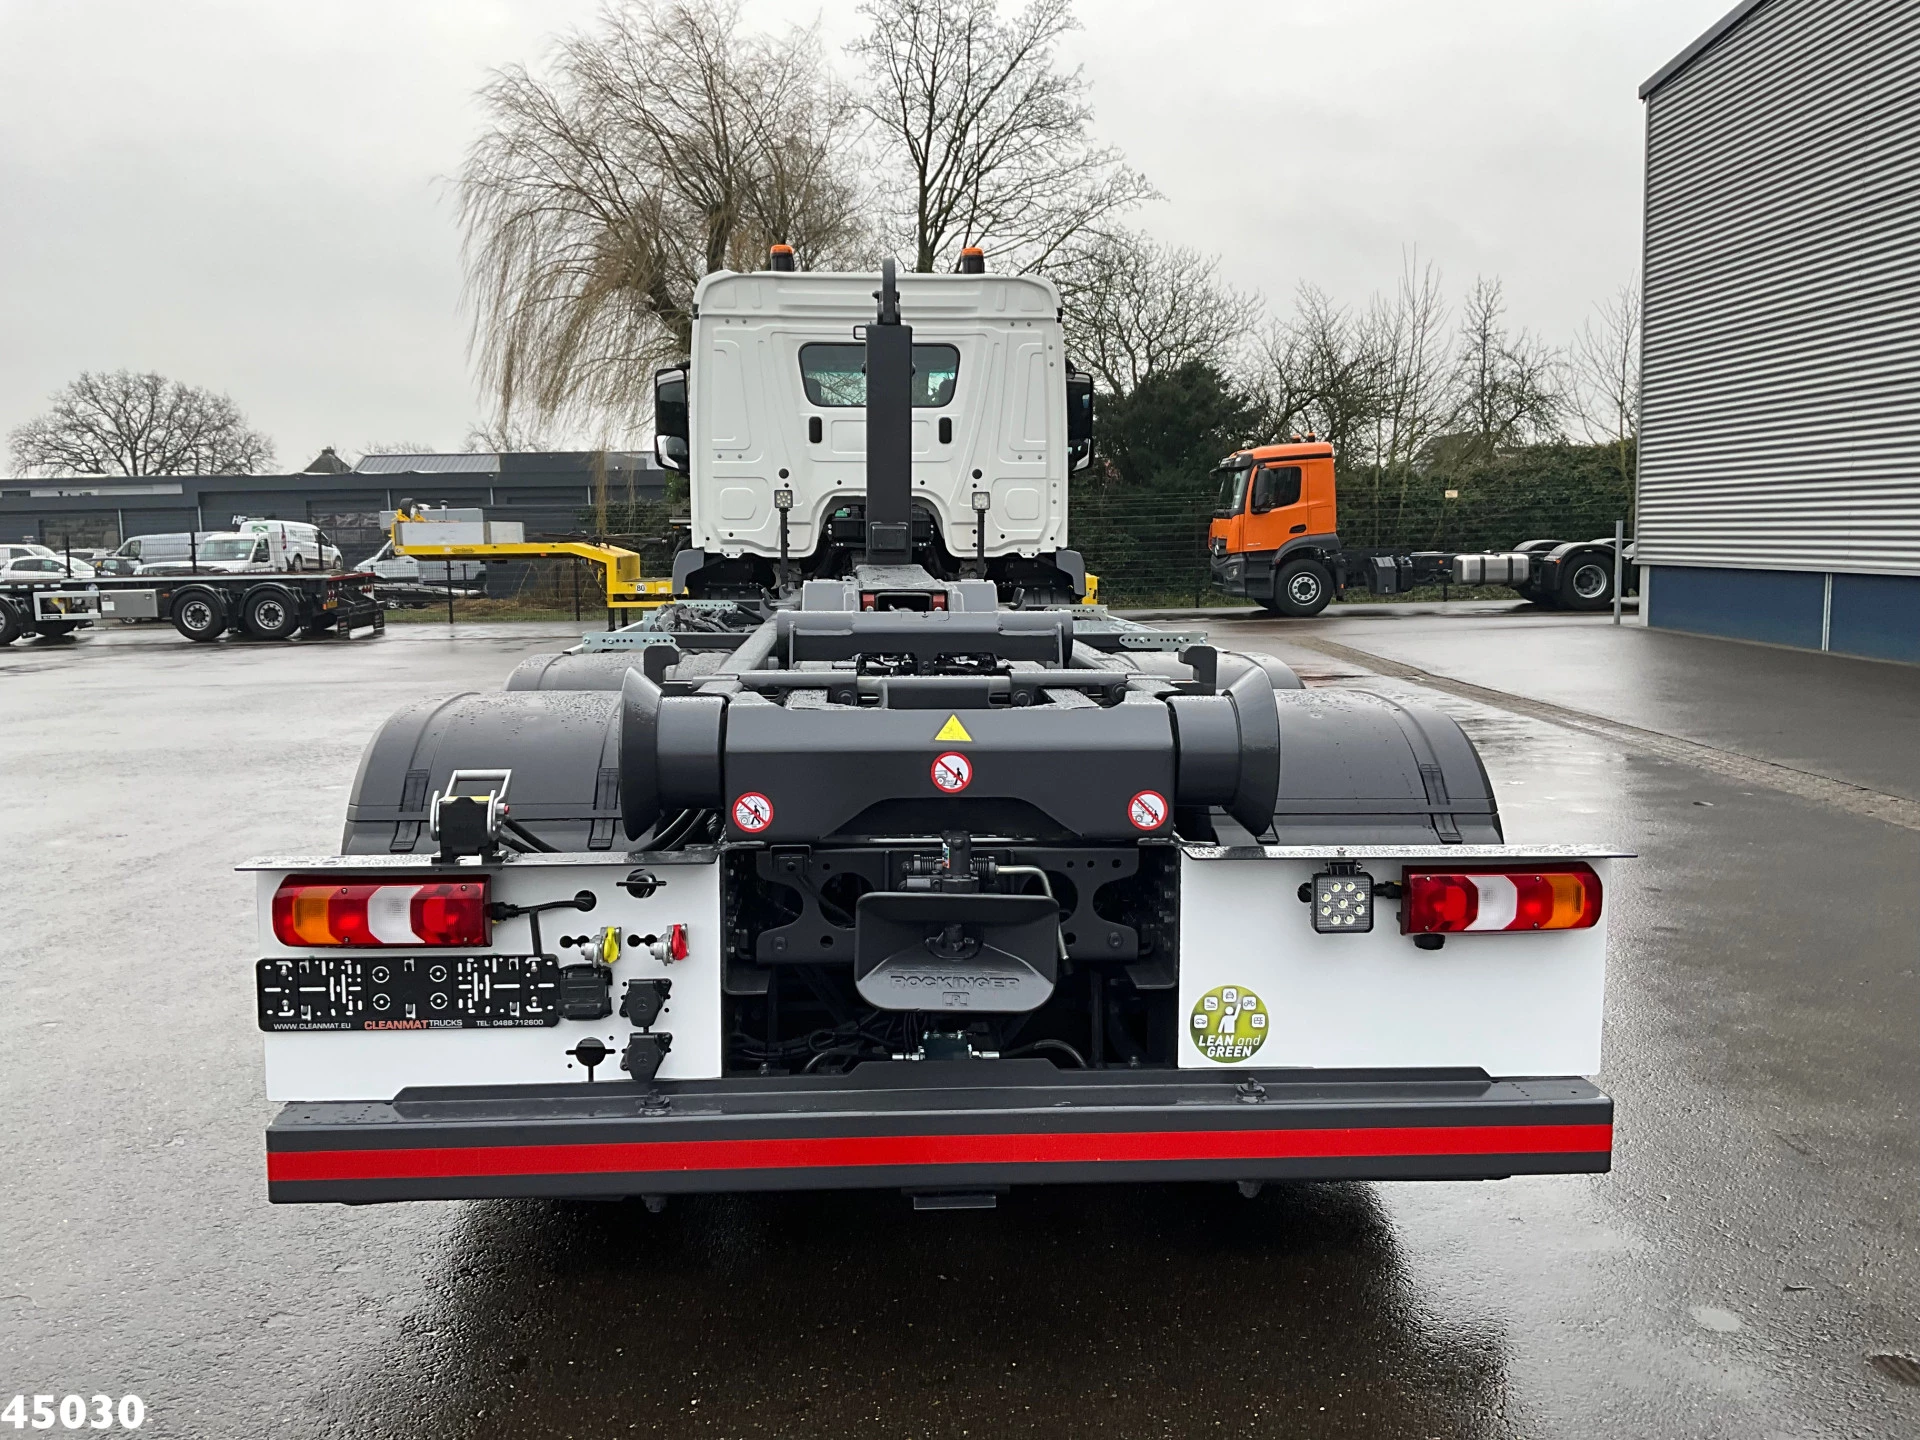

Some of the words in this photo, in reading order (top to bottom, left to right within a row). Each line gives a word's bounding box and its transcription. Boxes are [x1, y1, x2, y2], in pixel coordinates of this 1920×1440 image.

[636, 584, 646, 592] 80
[889, 976, 1020, 989] ROCKINGER
[273, 1022, 352, 1031] WWW.CLEANMAT.EU
[363, 1019, 430, 1031] CLEANMAT
[429, 1018, 463, 1028] TRUCKS
[492, 1018, 545, 1028] 0488-712600
[1198, 1034, 1234, 1047] LEAN
[1237, 1034, 1261, 1046] and
[1206, 1046, 1253, 1058] GREEN
